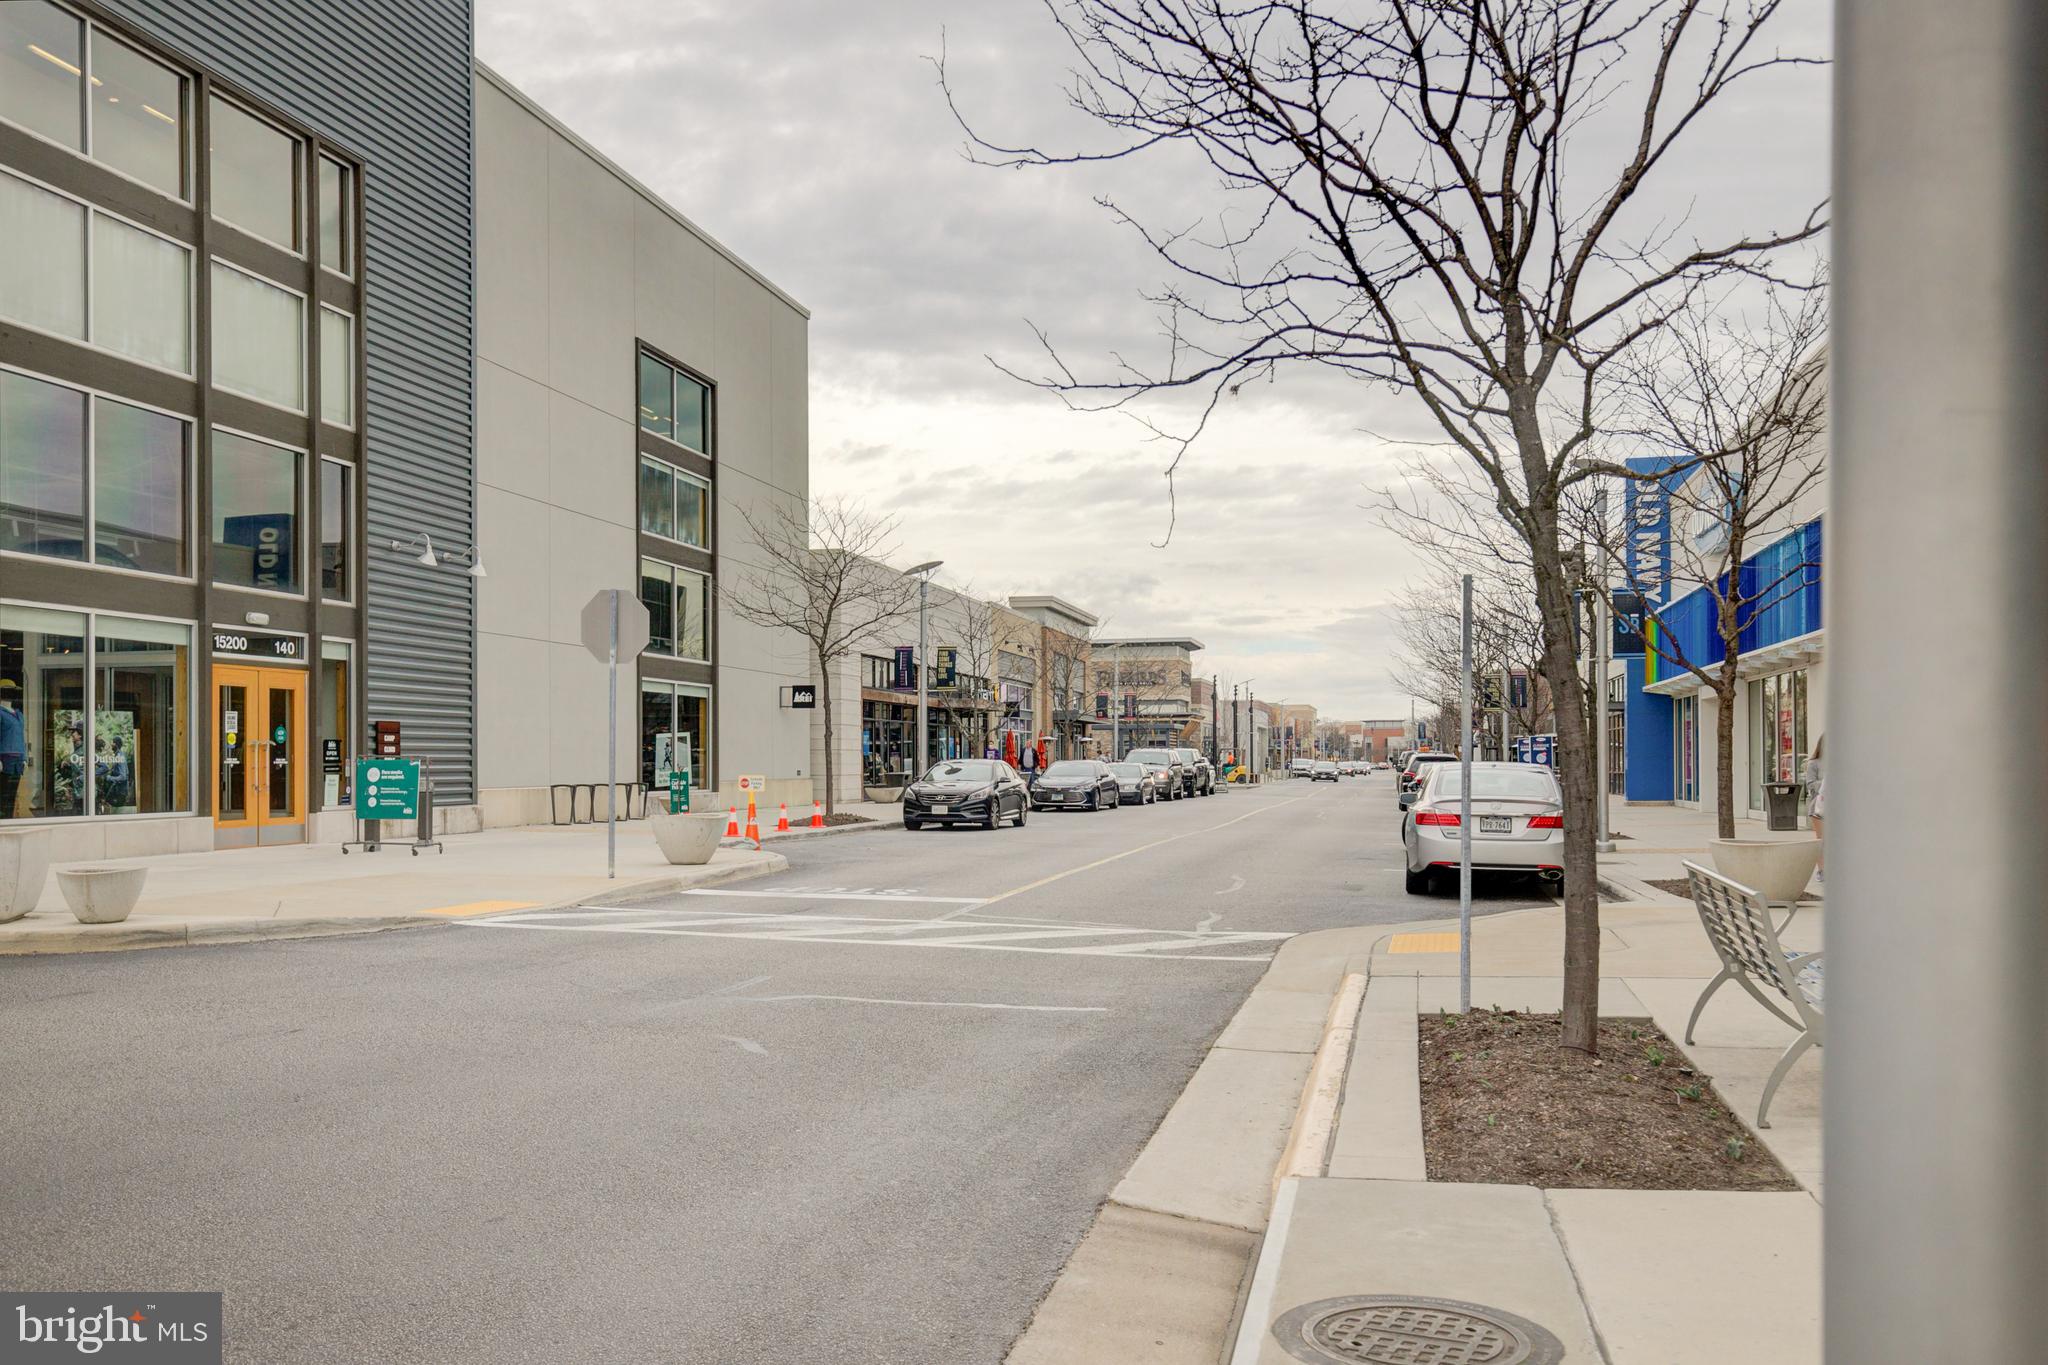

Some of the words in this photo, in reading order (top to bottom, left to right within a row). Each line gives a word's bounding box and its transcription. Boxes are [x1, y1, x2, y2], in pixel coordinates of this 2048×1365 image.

[1635, 476, 1661, 526] OLD
[1636, 532, 1662, 603] NAVY
[214, 635, 248, 650] 15200
[274, 641, 295, 655] 140
